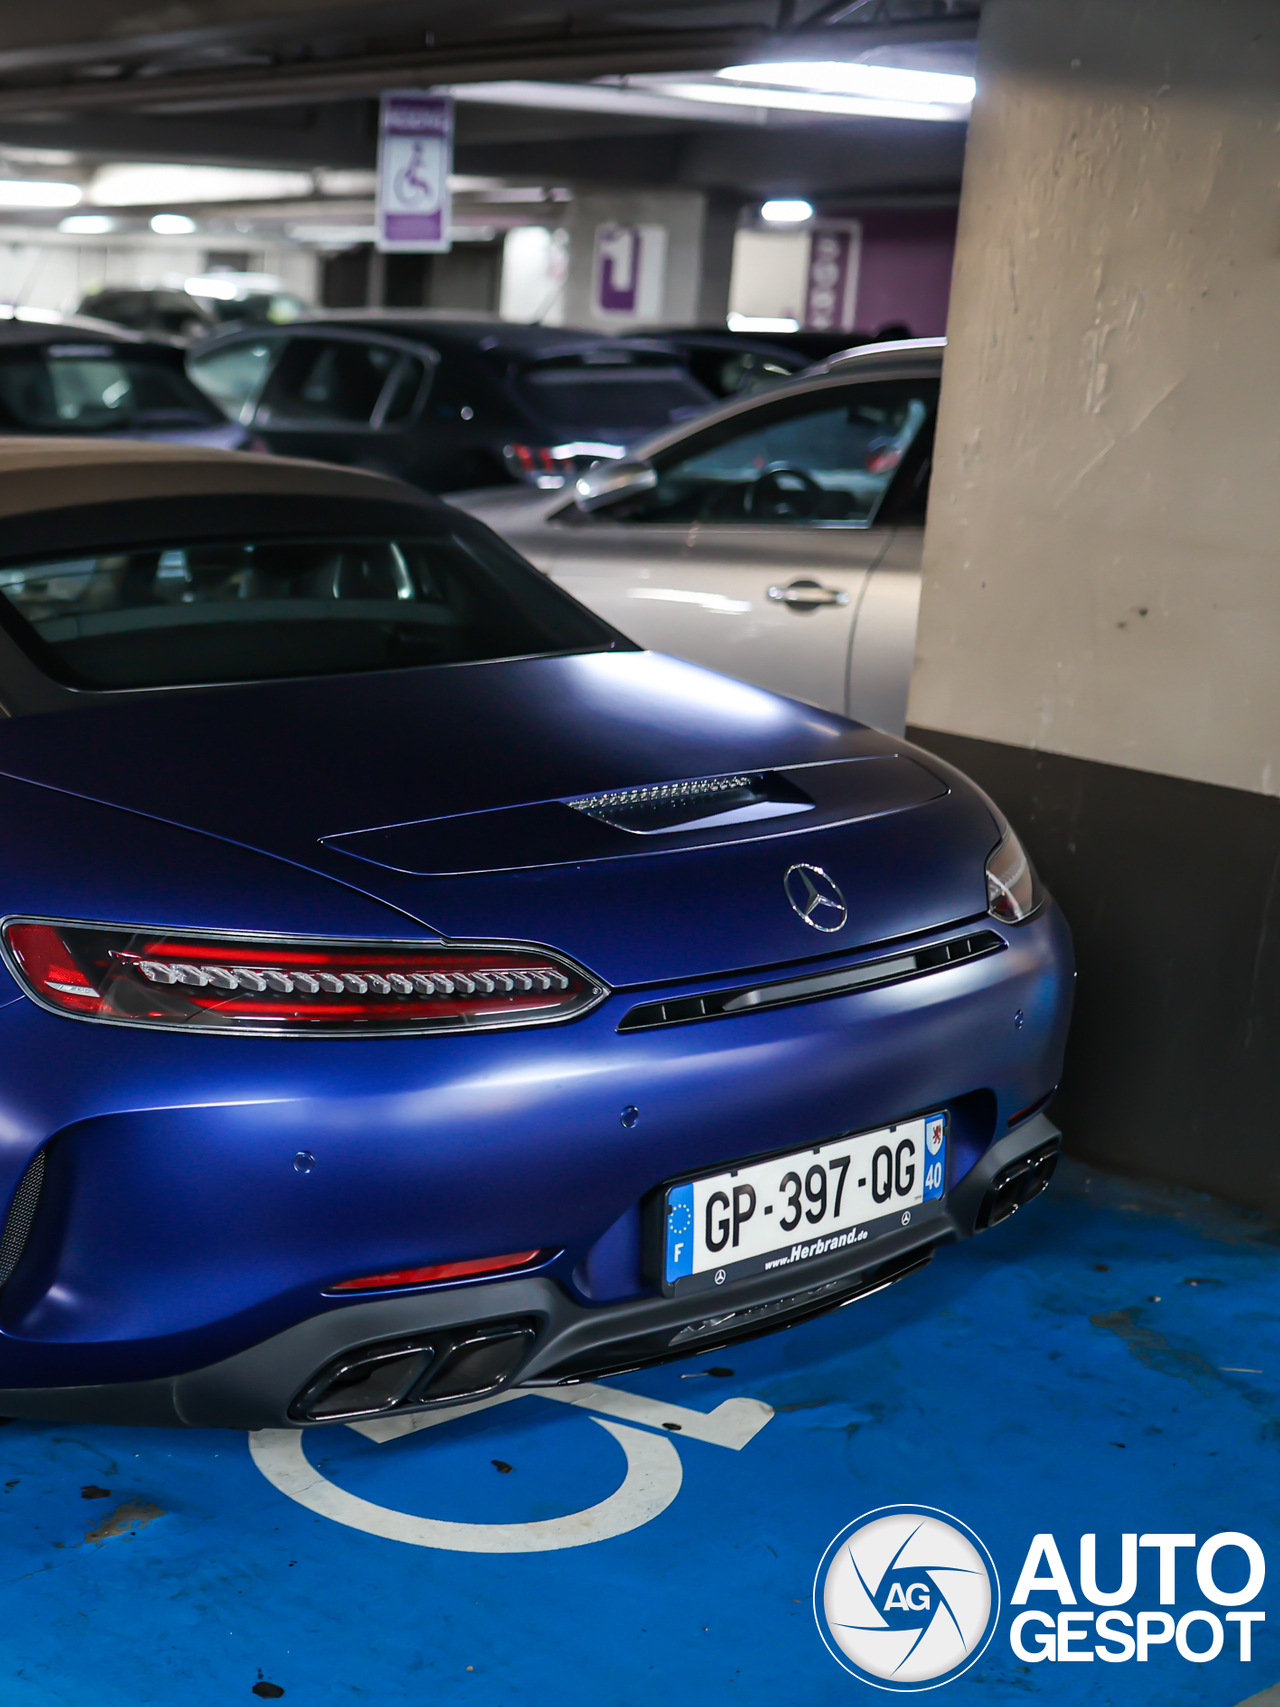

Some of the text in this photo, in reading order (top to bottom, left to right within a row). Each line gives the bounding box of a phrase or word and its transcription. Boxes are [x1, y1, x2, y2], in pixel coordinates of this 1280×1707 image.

[925, 1162, 942, 1190] 40
[705, 1139, 915, 1252] GP-397-QG
[674, 1243, 684, 1263] F
[765, 1228, 868, 1270] www.Herbrand.de
